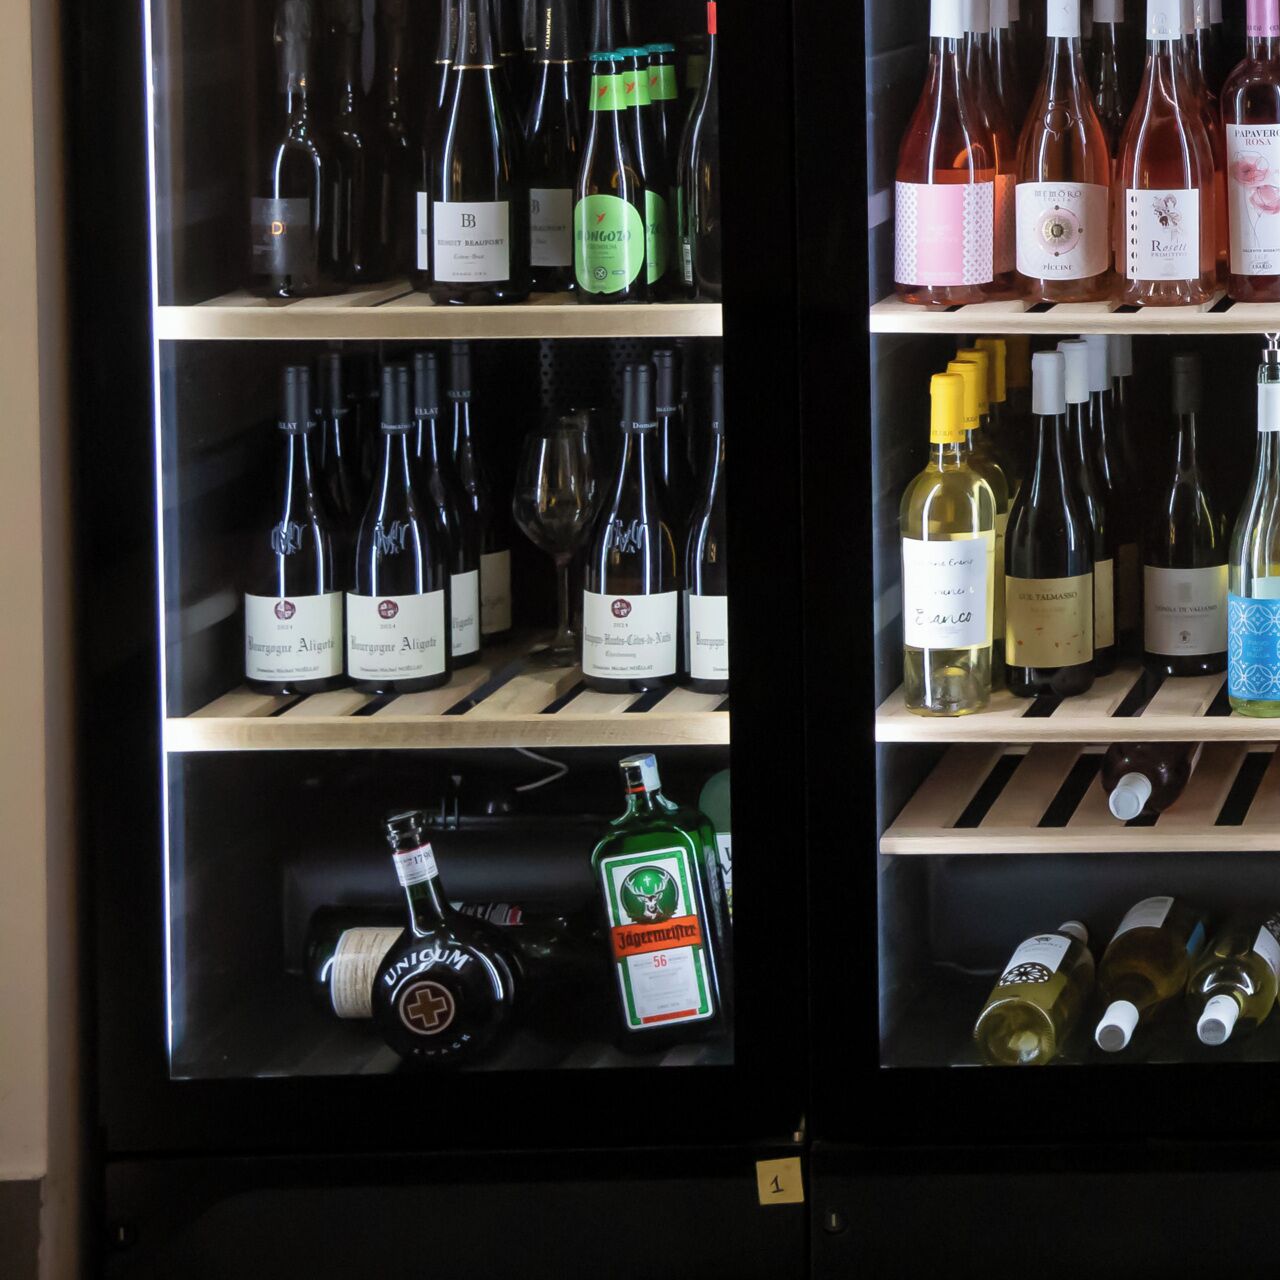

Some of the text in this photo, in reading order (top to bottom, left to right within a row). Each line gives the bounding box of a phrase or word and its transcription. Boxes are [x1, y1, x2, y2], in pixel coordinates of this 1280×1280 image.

[1244, 138, 1272, 146] ROSA
[384, 948, 470, 987] UNICUM
[652, 954, 668, 968] 56
[770, 1174, 785, 1194] 1
